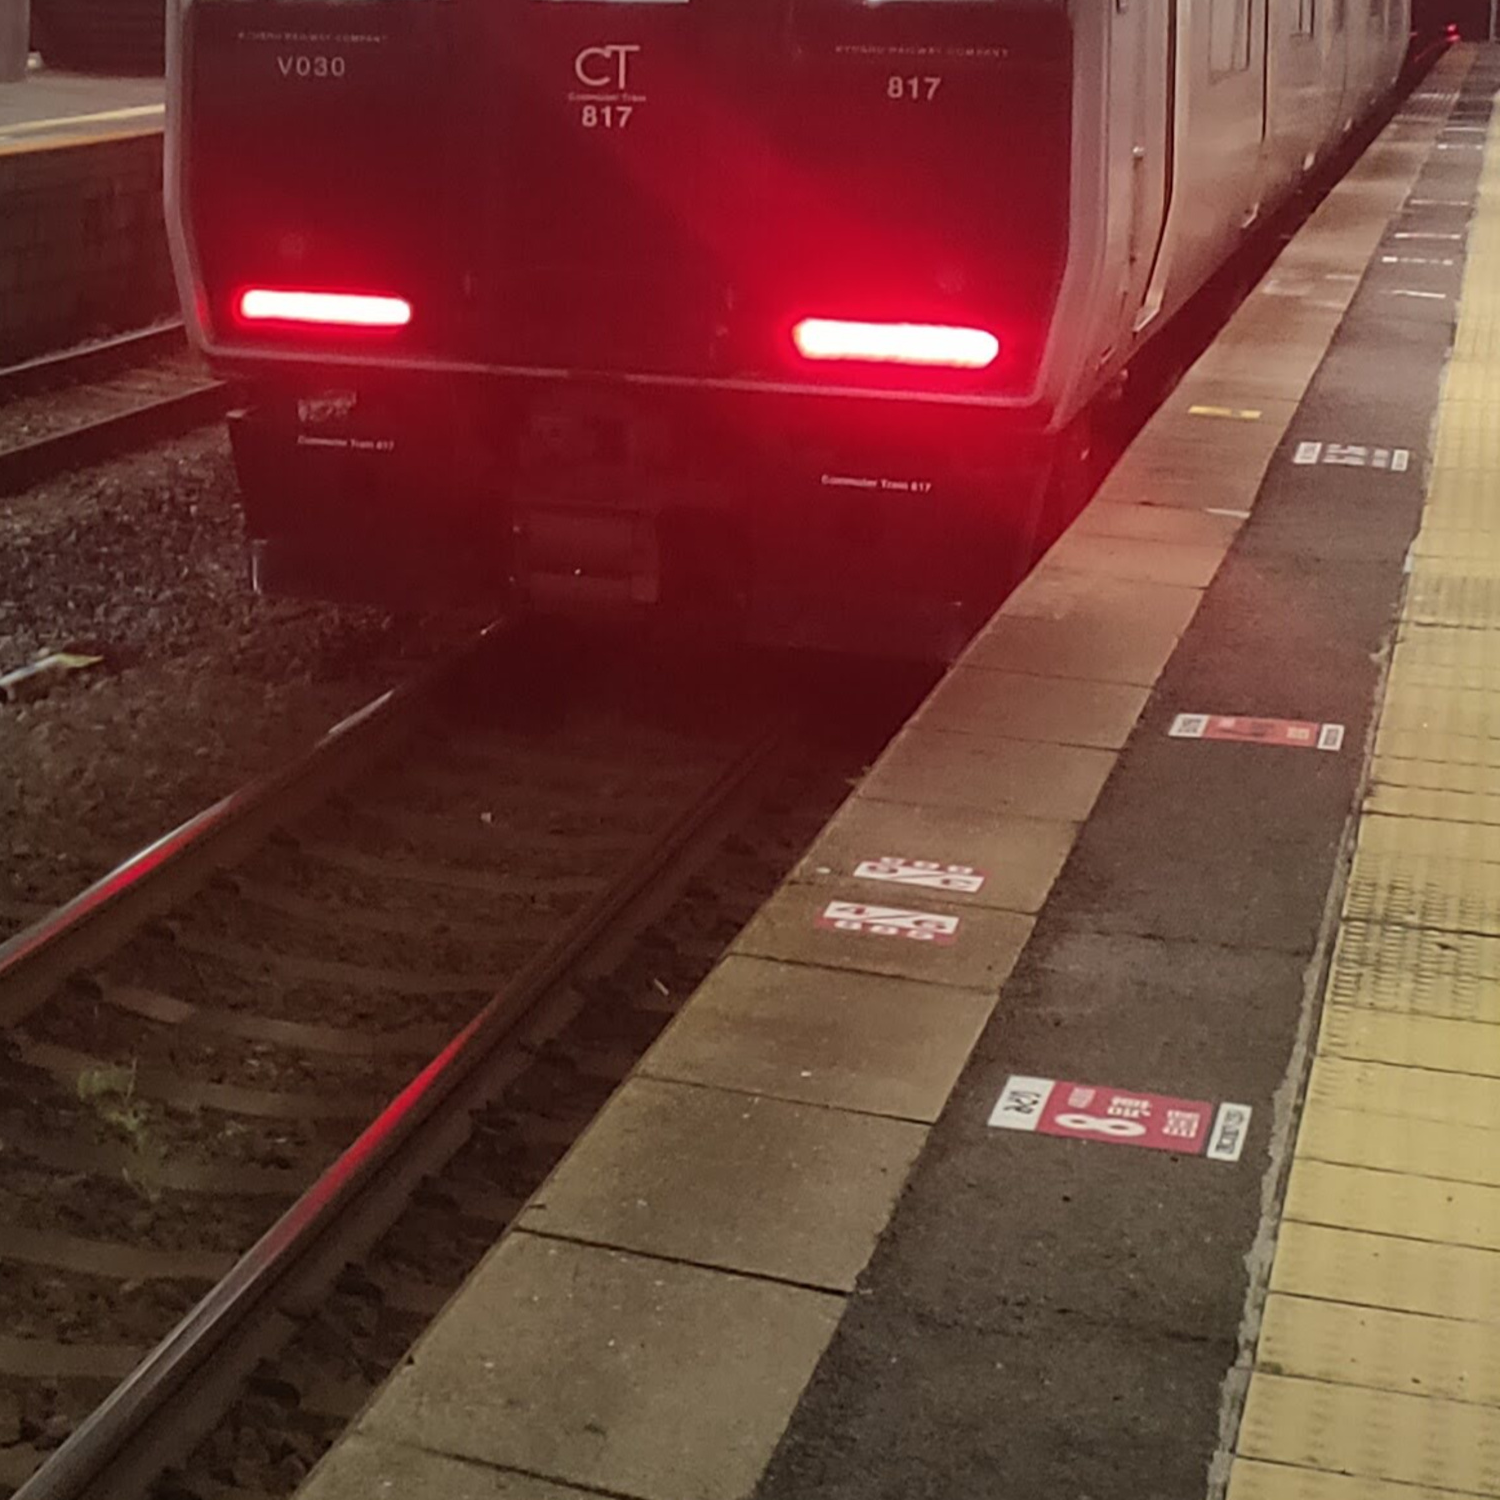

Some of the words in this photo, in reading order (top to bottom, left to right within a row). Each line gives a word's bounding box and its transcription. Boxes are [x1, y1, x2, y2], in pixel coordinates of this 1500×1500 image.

[276, 56, 346, 77] V030
[574, 44, 641, 90] CT
[886, 75, 942, 100] 817
[581, 104, 633, 128] 817
[910, 481, 932, 493] 817
